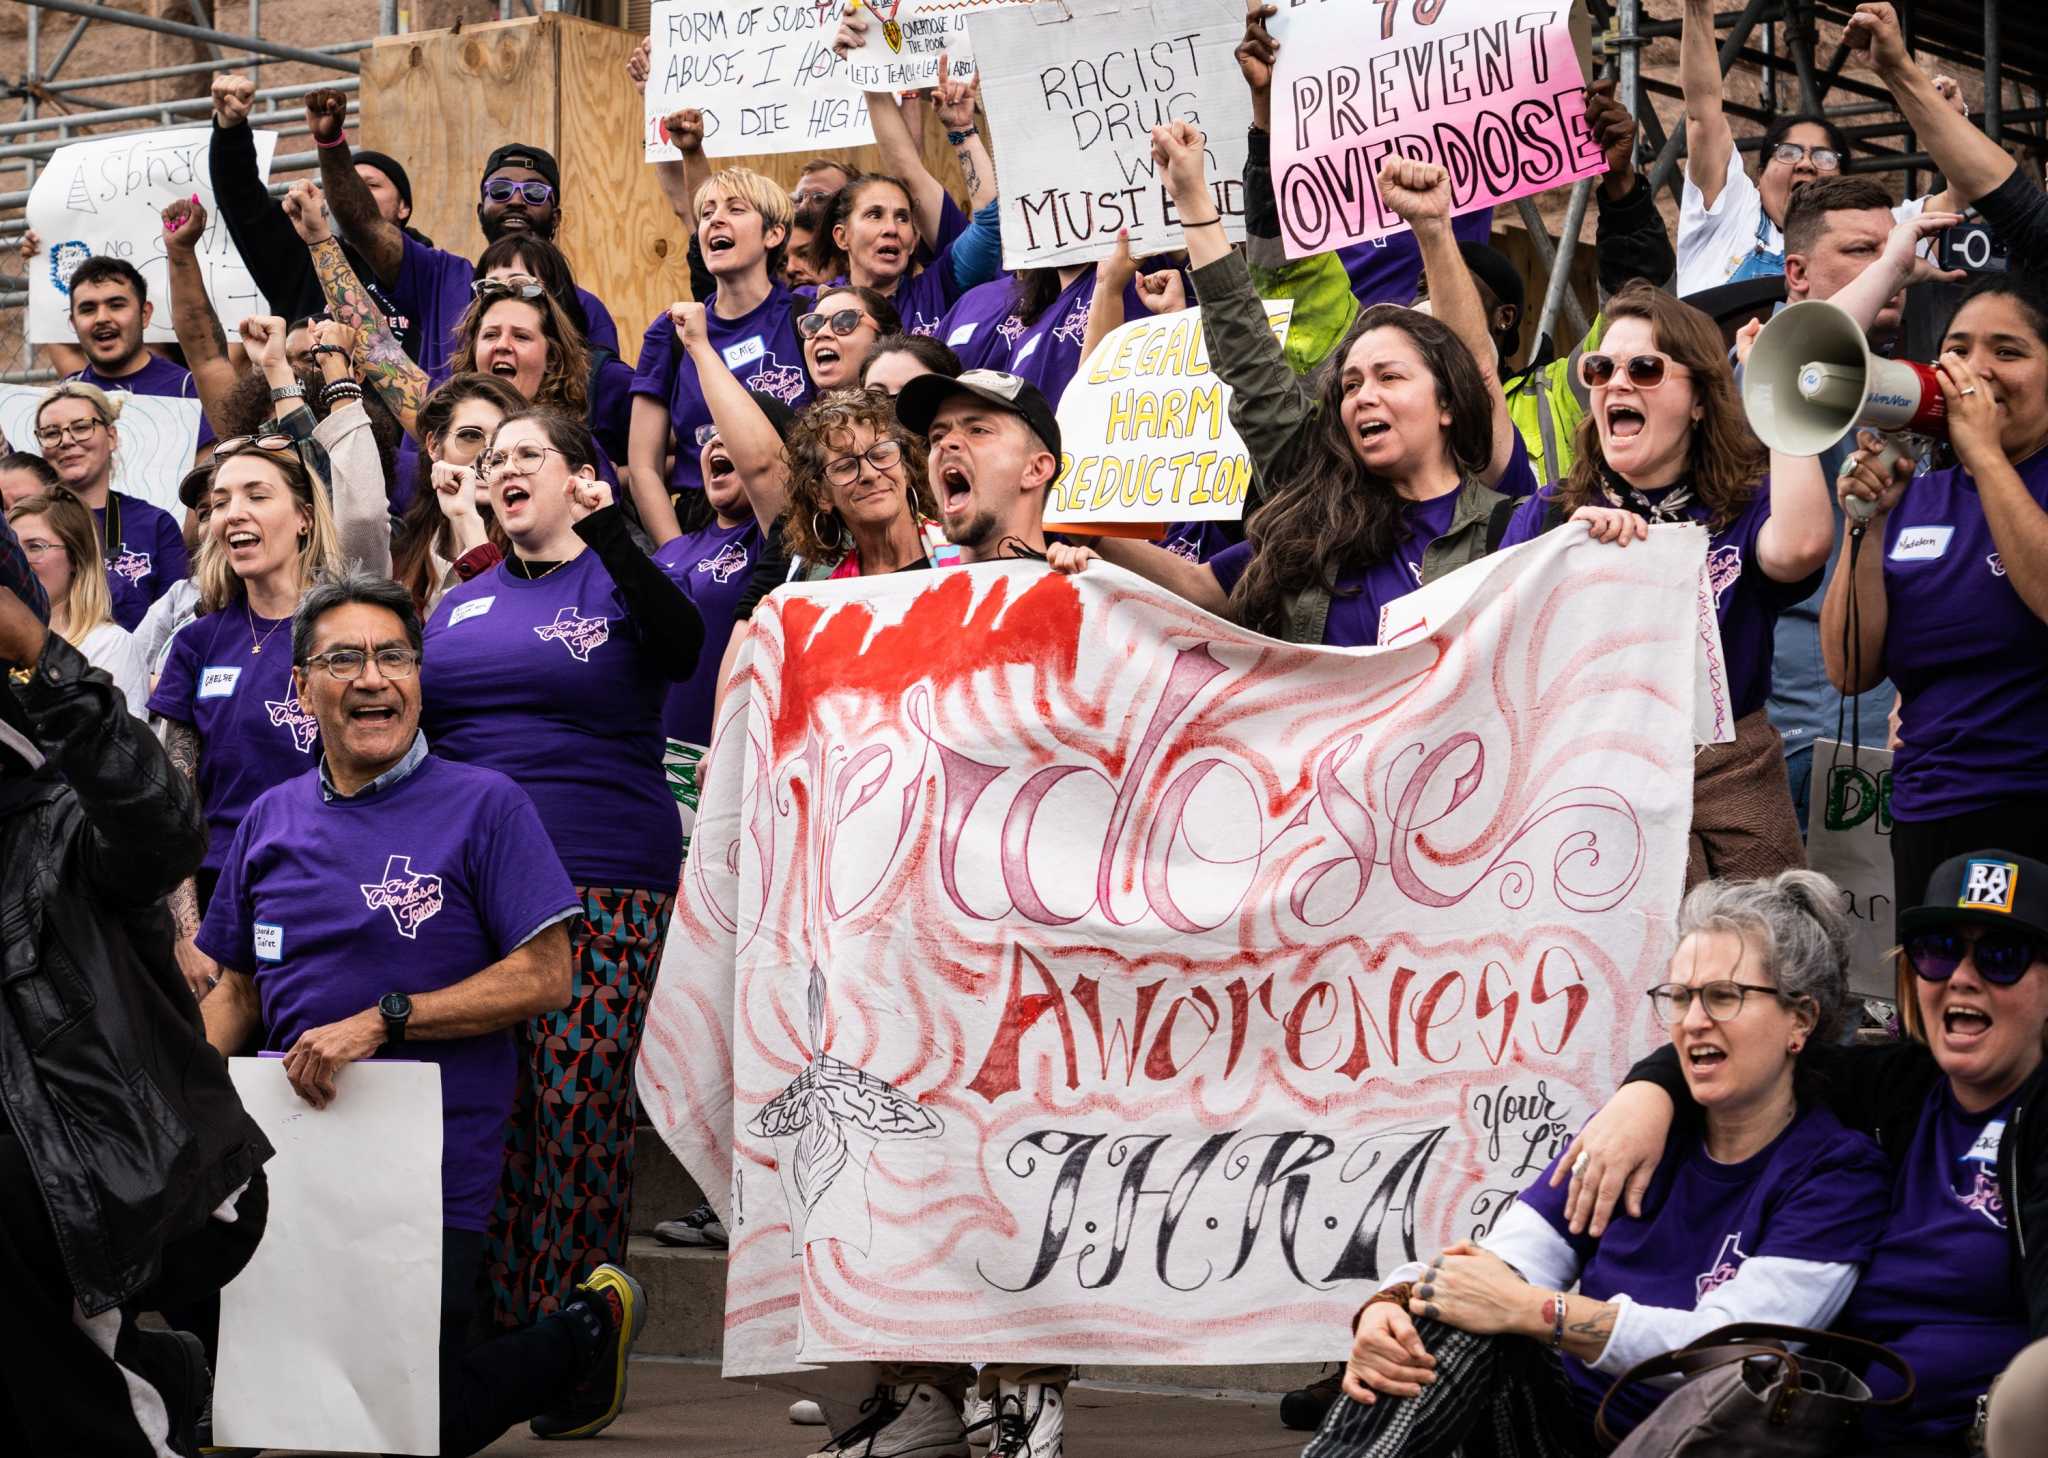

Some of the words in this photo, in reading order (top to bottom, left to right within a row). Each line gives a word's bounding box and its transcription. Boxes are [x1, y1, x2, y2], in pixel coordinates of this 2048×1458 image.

[668, 11, 728, 48] FORM
[737, 7, 764, 36] OF
[767, 0, 845, 33] SUBSTAN
[902, 16, 949, 40] OVERDOSE
[954, 14, 964, 31] IS
[664, 49, 744, 95] ABUSE,
[752, 45, 787, 88] I
[794, 40, 848, 87] HOP
[883, 62, 915, 85] TEACH
[921, 58, 951, 78] LEA
[953, 57, 978, 78] ABOU
[1040, 33, 1201, 111] RACIST
[1292, 11, 1557, 151] PREVENT
[741, 104, 790, 136] DIE
[807, 95, 868, 139] HIGH
[1072, 92, 1201, 151] DRUG
[1015, 186, 1146, 251] MUST
[1105, 382, 1223, 445] HARM
[1050, 450, 1252, 513] REDUCTION
[1970, 864, 2008, 889] RA
[1473, 1080, 1570, 1162] Your
